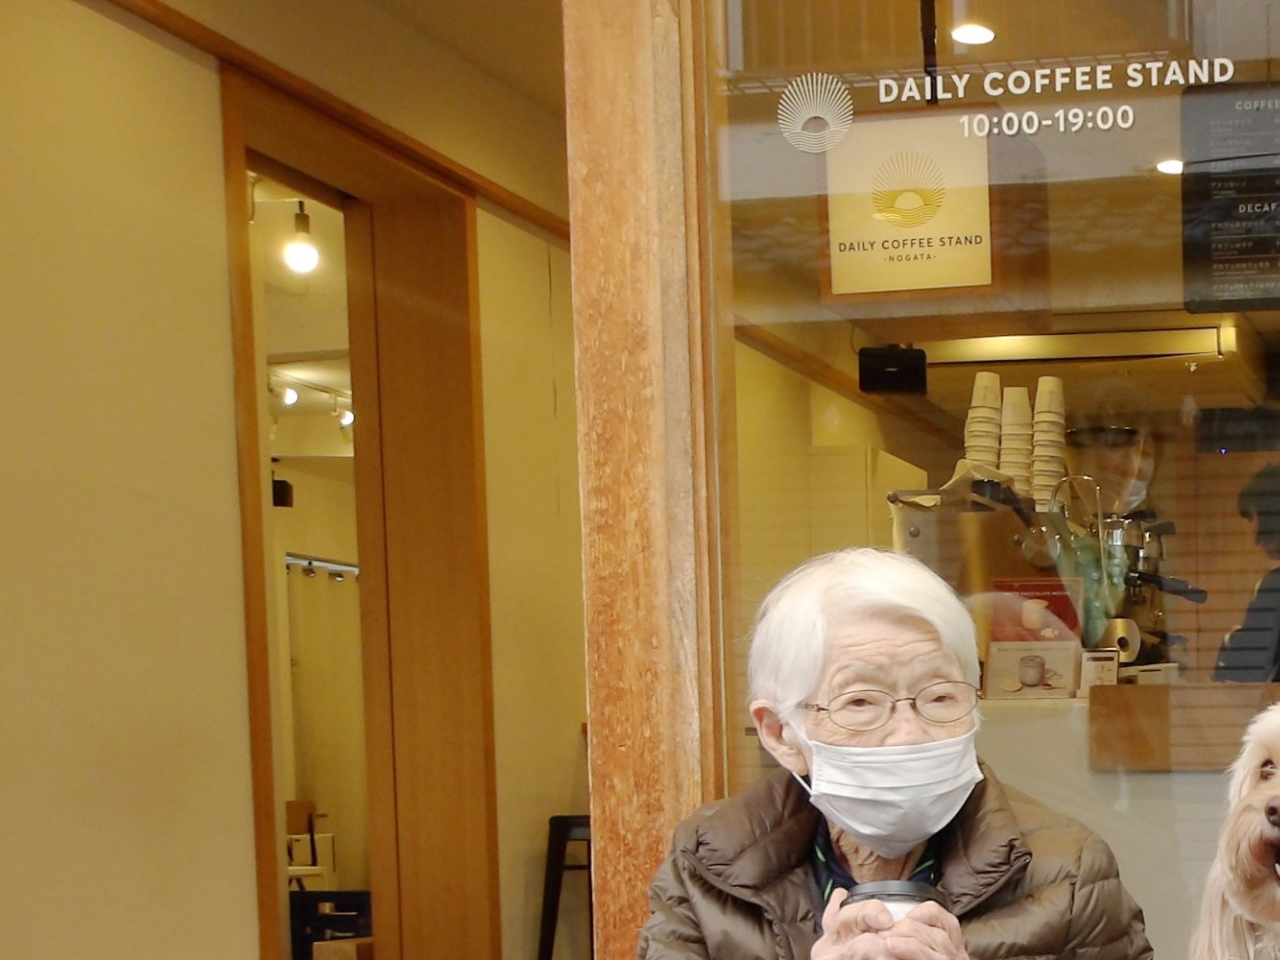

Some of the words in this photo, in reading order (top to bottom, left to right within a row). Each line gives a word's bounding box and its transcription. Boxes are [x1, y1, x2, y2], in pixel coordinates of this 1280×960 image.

[878, 73, 971, 103] DAILY
[983, 64, 1113, 97] COFFEE
[1126, 57, 1235, 88] STAND
[958, 104, 1135, 138] 10:00-19:00
[1238, 202, 1278, 213] DECAF
[838, 241, 876, 253] DAILY
[881, 237, 934, 250] COFFEE
[939, 234, 984, 247] STAND
